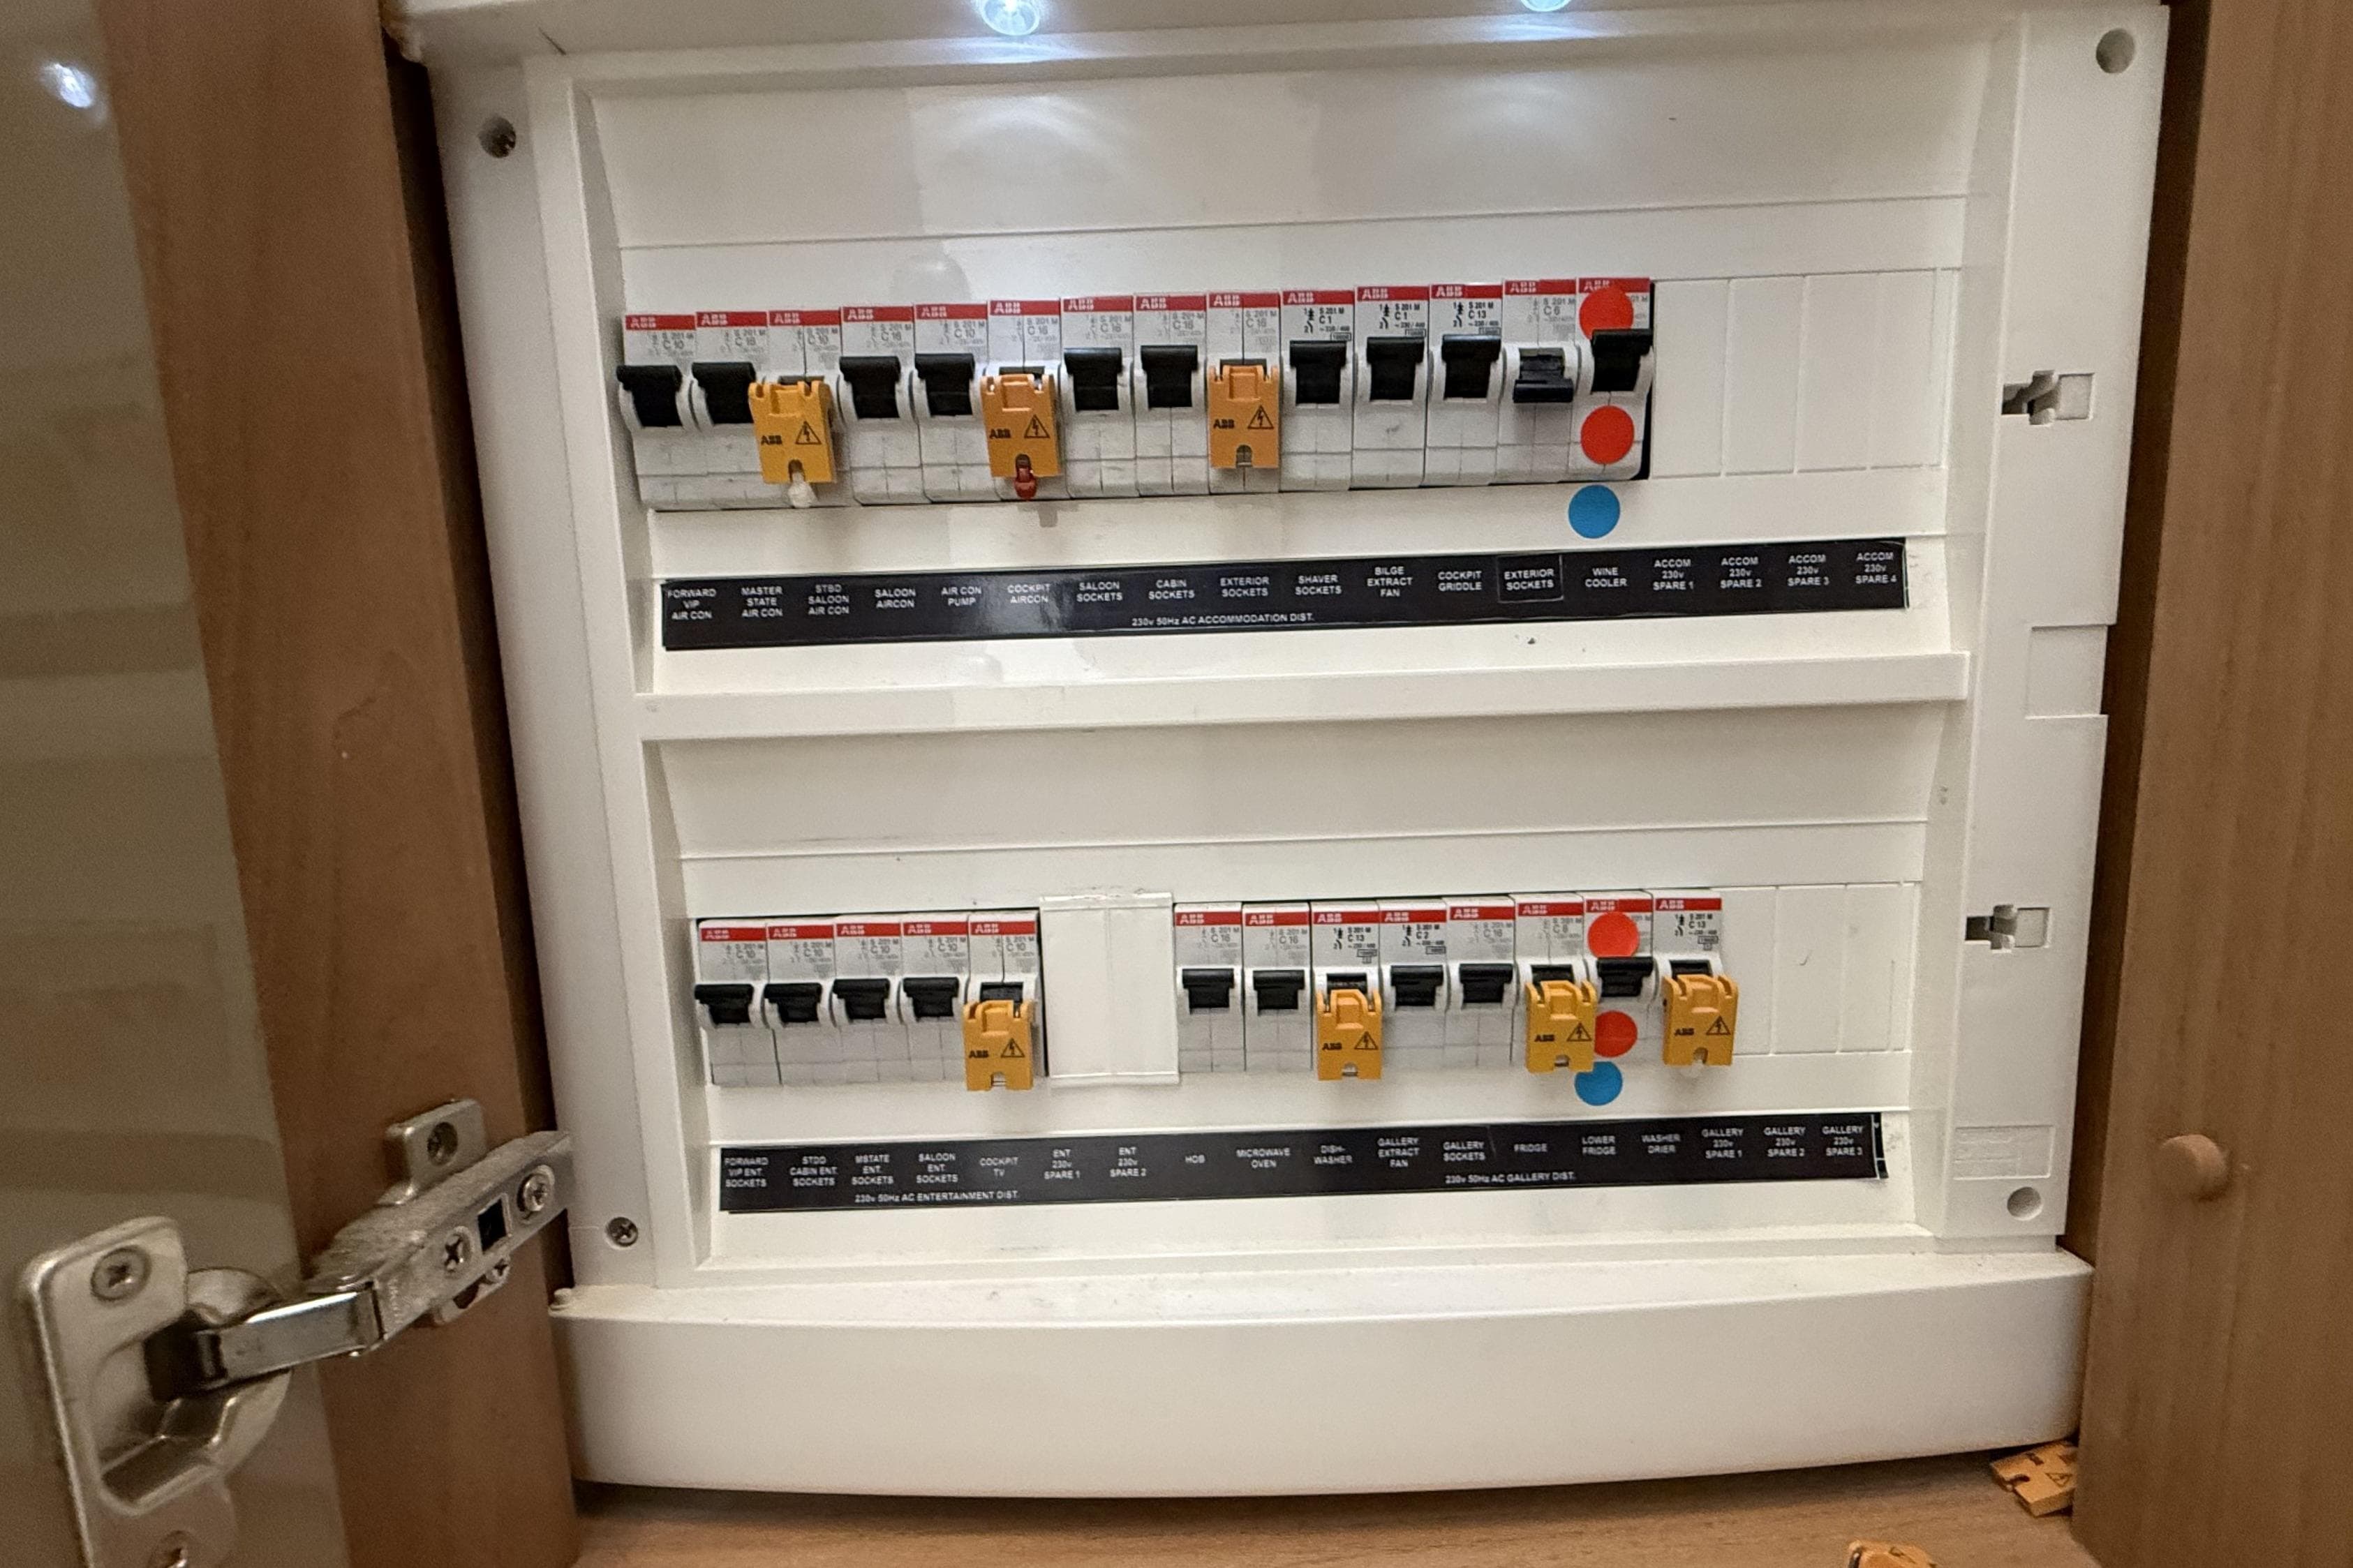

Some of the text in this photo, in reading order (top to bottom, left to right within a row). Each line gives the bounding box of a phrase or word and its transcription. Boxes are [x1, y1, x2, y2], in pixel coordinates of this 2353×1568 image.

[1437, 286, 1462, 297] ABB
[1510, 282, 1536, 293] ABB
[1288, 292, 1314, 303] ABB
[1362, 288, 1388, 299] ABB
[1068, 299, 1094, 310] ABB
[1141, 298, 1166, 309] ABB
[1214, 294, 1240, 306] ABB
[921, 306, 947, 317] ABB
[995, 302, 1020, 313] ABB
[702, 313, 727, 325] ABB
[774, 313, 801, 324] ABB
[847, 309, 873, 320] ABB
[630, 317, 656, 328] ABB
[1213, 419, 1235, 428] ABB
[989, 429, 1011, 439] ABB
[761, 435, 782, 445] ABB
[1789, 555, 1826, 563] ACCOM
[1857, 552, 1894, 560] ACCOM
[1654, 559, 1691, 567] ACCOM
[1721, 557, 1758, 565] ACCOM
[1375, 567, 1404, 575] BILGE
[1438, 571, 1481, 580] COCKPIT
[1504, 569, 1554, 581] EXTERIOR
[1593, 567, 1618, 576] WINE
[1220, 577, 1269, 586] EXTERIOR
[1299, 575, 1337, 583] SHAVER
[1367, 577, 1412, 586] EXTRACT
[1585, 578, 1627, 587] COOLER
[1721, 579, 1753, 588] SPARE
[1788, 576, 1829, 586] SPARE 3
[1856, 575, 1888, 583] SPARE
[1007, 584, 1050, 593] COCKPIT
[1079, 582, 1120, 590] SALOON
[1156, 580, 1187, 588] CABIN
[1439, 582, 1481, 591] GRIDDLE
[1506, 578, 1554, 590] SOCKETS
[1654, 581, 1686, 590] SPARE
[666, 589, 716, 598] FORWARD
[741, 586, 782, 595] MASTER
[875, 588, 916, 597] SALOON
[960, 586, 981, 595] CON
[1149, 590, 1194, 599] SOCKETS
[1222, 588, 1268, 597] SOCKETS
[1296, 585, 1342, 595] SOCKETS
[747, 597, 776, 606] STATE
[808, 595, 849, 604] SALOON
[948, 597, 976, 606] PUMP
[1010, 595, 1048, 604] AIRCON
[1077, 592, 1122, 602] SOCKETS
[877, 599, 914, 608] AIRCON
[761, 608, 782, 617] CON
[808, 606, 849, 615] AIR CON
[690, 611, 712, 620] CON
[1182, 616, 1196, 625] AC
[1198, 614, 1289, 624] ACCOMMODATION
[1659, 900, 1684, 909] ABB
[1317, 913, 1342, 923] ABB
[1385, 912, 1409, 921] ABB
[1454, 909, 1478, 918] ABB
[1180, 914, 1204, 924] ABB
[1249, 914, 1274, 924] ABB
[969, 1050, 989, 1059] ABB
[1702, 1128, 1743, 1137] GALLERY
[1764, 1127, 1805, 1135] GALLERY
[1823, 1126, 1863, 1134] GALLERY
[1378, 1137, 1418, 1146] GALLERY
[1582, 1136, 1615, 1144] LOWER
[1642, 1134, 1680, 1142] WASHER
[1443, 1142, 1484, 1150] GALLERY
[1514, 1144, 1547, 1152] FRIDGE
[1648, 1145, 1675, 1153] DRIER
[1053, 1149, 1070, 1158] ENT
[1236, 1149, 1290, 1157] MICROWAVE
[1378, 1148, 1419, 1157] EXTRACT
[1582, 1147, 1616, 1155] FRIDGE
[1706, 1150, 1735, 1158] SPARE
[1768, 1149, 1797, 1157] SPARE
[1826, 1147, 1855, 1156] SPARE
[919, 1153, 956, 1161] SALOON
[980, 1157, 1018, 1165] COCKPIT
[1185, 1155, 1205, 1163] HOB
[1314, 1156, 1352, 1164] WASHER
[1443, 1152, 1485, 1161] SOCKETS
[1252, 1160, 1276, 1168] OVEN
[1044, 1170, 1073, 1179] SPARE
[1110, 1168, 1146, 1177] SPARE 2
[793, 1177, 835, 1186] SOCKETS
[852, 1176, 893, 1185] SOCKETS
[916, 1174, 958, 1183] SOCKETS
[1507, 1173, 1550, 1182] GALLERY
[726, 1179, 766, 1187] SOCKETS
[917, 1192, 994, 1201] ENTERTAINMENT
